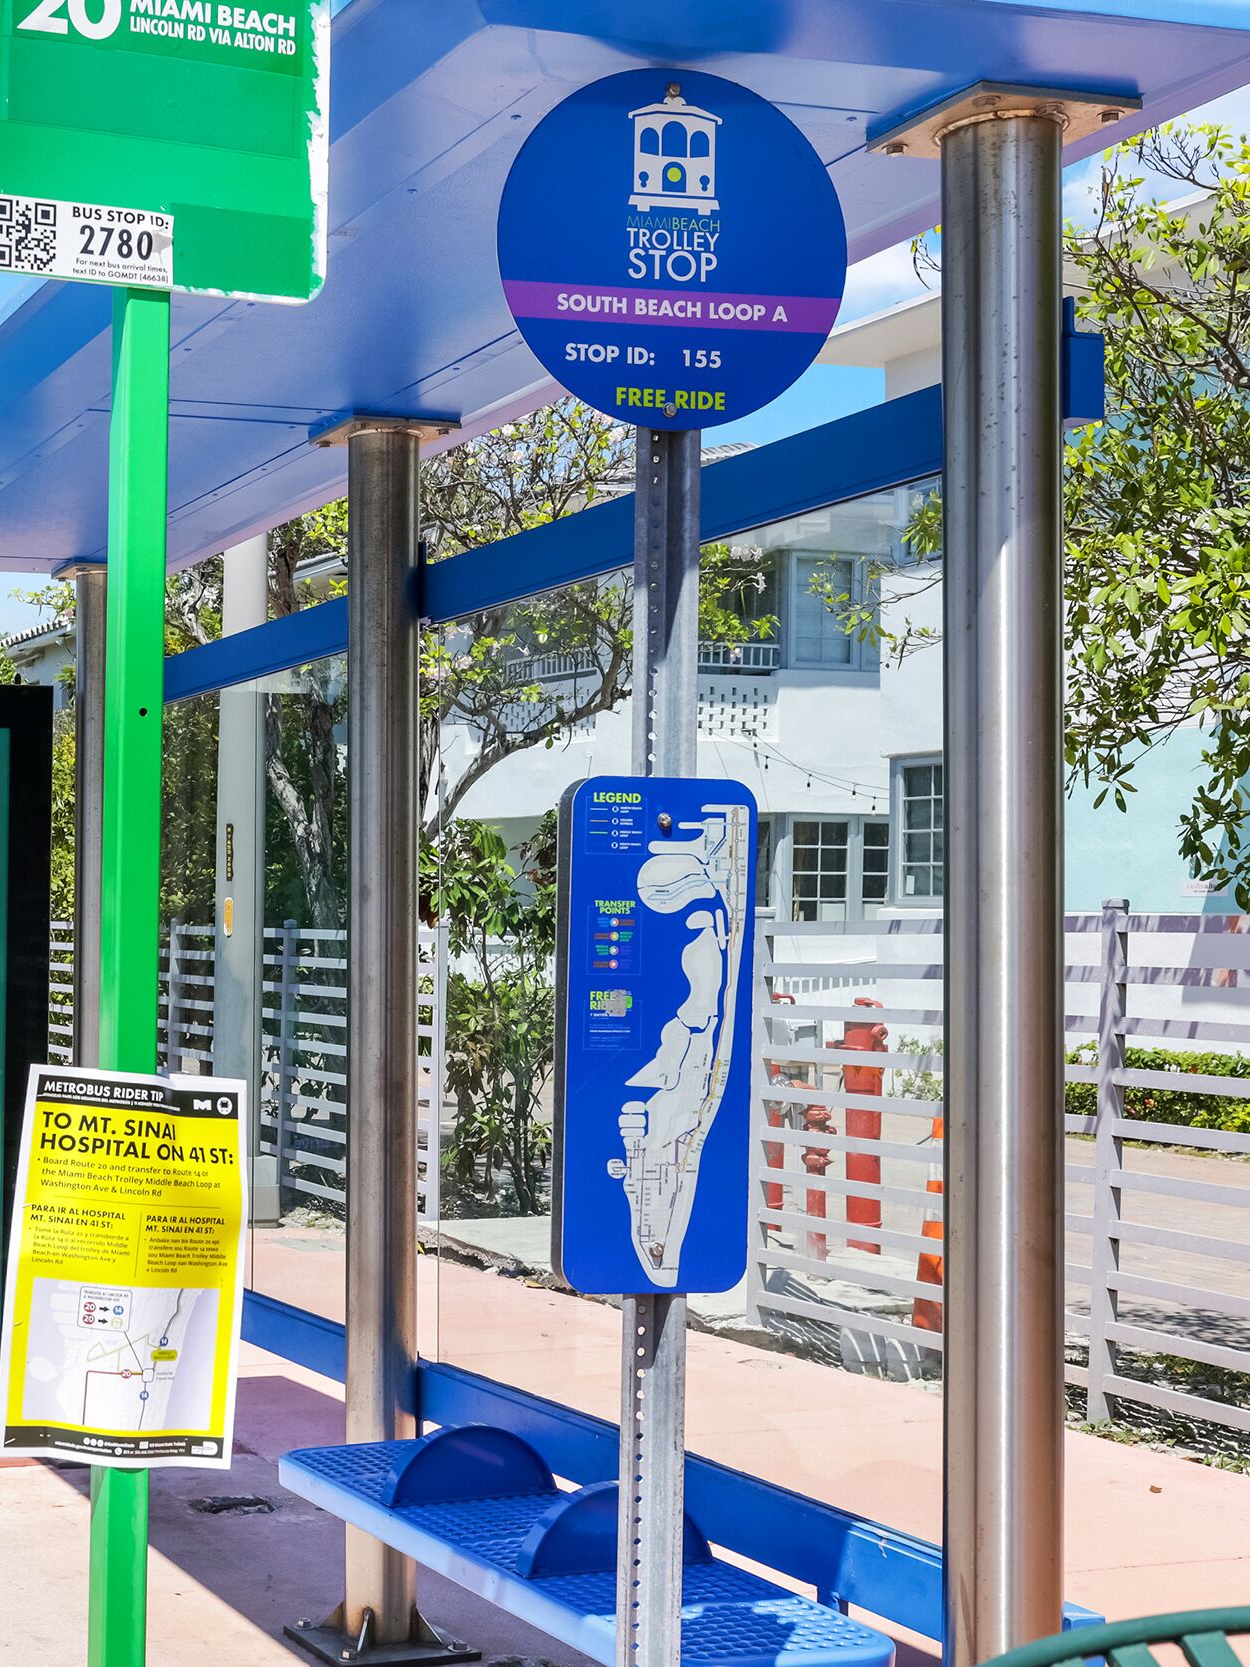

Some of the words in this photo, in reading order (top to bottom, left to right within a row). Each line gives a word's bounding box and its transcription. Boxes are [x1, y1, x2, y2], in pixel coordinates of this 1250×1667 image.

[129, 0, 211, 24] MIAMI
[217, 4, 296, 37] BEACH
[129, 16, 184, 39] LINCOLN
[187, 25, 206, 41] RD
[209, 27, 231, 46] VIA
[234, 30, 274, 53] ALTON
[278, 38, 296, 56] RD
[72, 206, 102, 220] BUS
[107, 210, 145, 224] STOP
[150, 215, 169, 229] ID:
[79, 224, 153, 260] 2780
[626, 227, 719, 251] TROLLEY
[90, 259, 105, 267] next
[107, 261, 120, 269] bus
[122, 263, 146, 271] arrival
[108, 270, 137, 280] GOMDT
[628, 248, 717, 282] STOP
[557, 293, 627, 314] SOUTH
[635, 298, 701, 318] BEACH
[709, 302, 766, 322] LOOP
[772, 305, 788, 322] A
[565, 342, 620, 363] STOP
[627, 347, 655, 366] ID:
[683, 349, 722, 369] 155
[616, 387, 666, 409] FREE
[674, 390, 726, 411] RIDE
[593, 792, 641, 803] LEGEND
[595, 900, 636, 908] TRANSFER
[44, 1080, 111, 1098] METROBUS
[114, 1087, 148, 1101] RIDER
[150, 1090, 164, 1102] TIP
[43, 1111, 72, 1129] TO
[78, 1115, 116, 1135] MT.
[124, 1119, 176, 1140] SINAI
[40, 1132, 150, 1159] HOSPITAL
[157, 1143, 184, 1162] ON
[189, 1146, 206, 1163] 41
[210, 1147, 233, 1165] ST:
[43, 1156, 68, 1166] Board
[70, 1159, 95, 1168] Route
[110, 1164, 126, 1172] and
[128, 1165, 161, 1174] transfer
[40, 1179, 91, 1191] Washington
[93, 1184, 109, 1192] Ave
[119, 1187, 150, 1196] Lincoln
[151, 1189, 162, 1197] Rd
[58, 1169, 85, 1178] Miami
[87, 1172, 113, 1182] Beach
[115, 1175, 143, 1186] Trolley
[145, 1178, 172, 1187] Middle
[173, 1180, 195, 1188] Beach
[196, 1181, 212, 1189] Loop
[30, 1214, 46, 1222] MT.
[48, 1215, 73, 1225] SINAI
[76, 1218, 88, 1226] EN
[31, 1203, 55, 1213] PARA
[57, 1206, 66, 1214] IR
[81, 1209, 126, 1220] HOSPITAL
[189, 1217, 225, 1225] HOSPITAL
